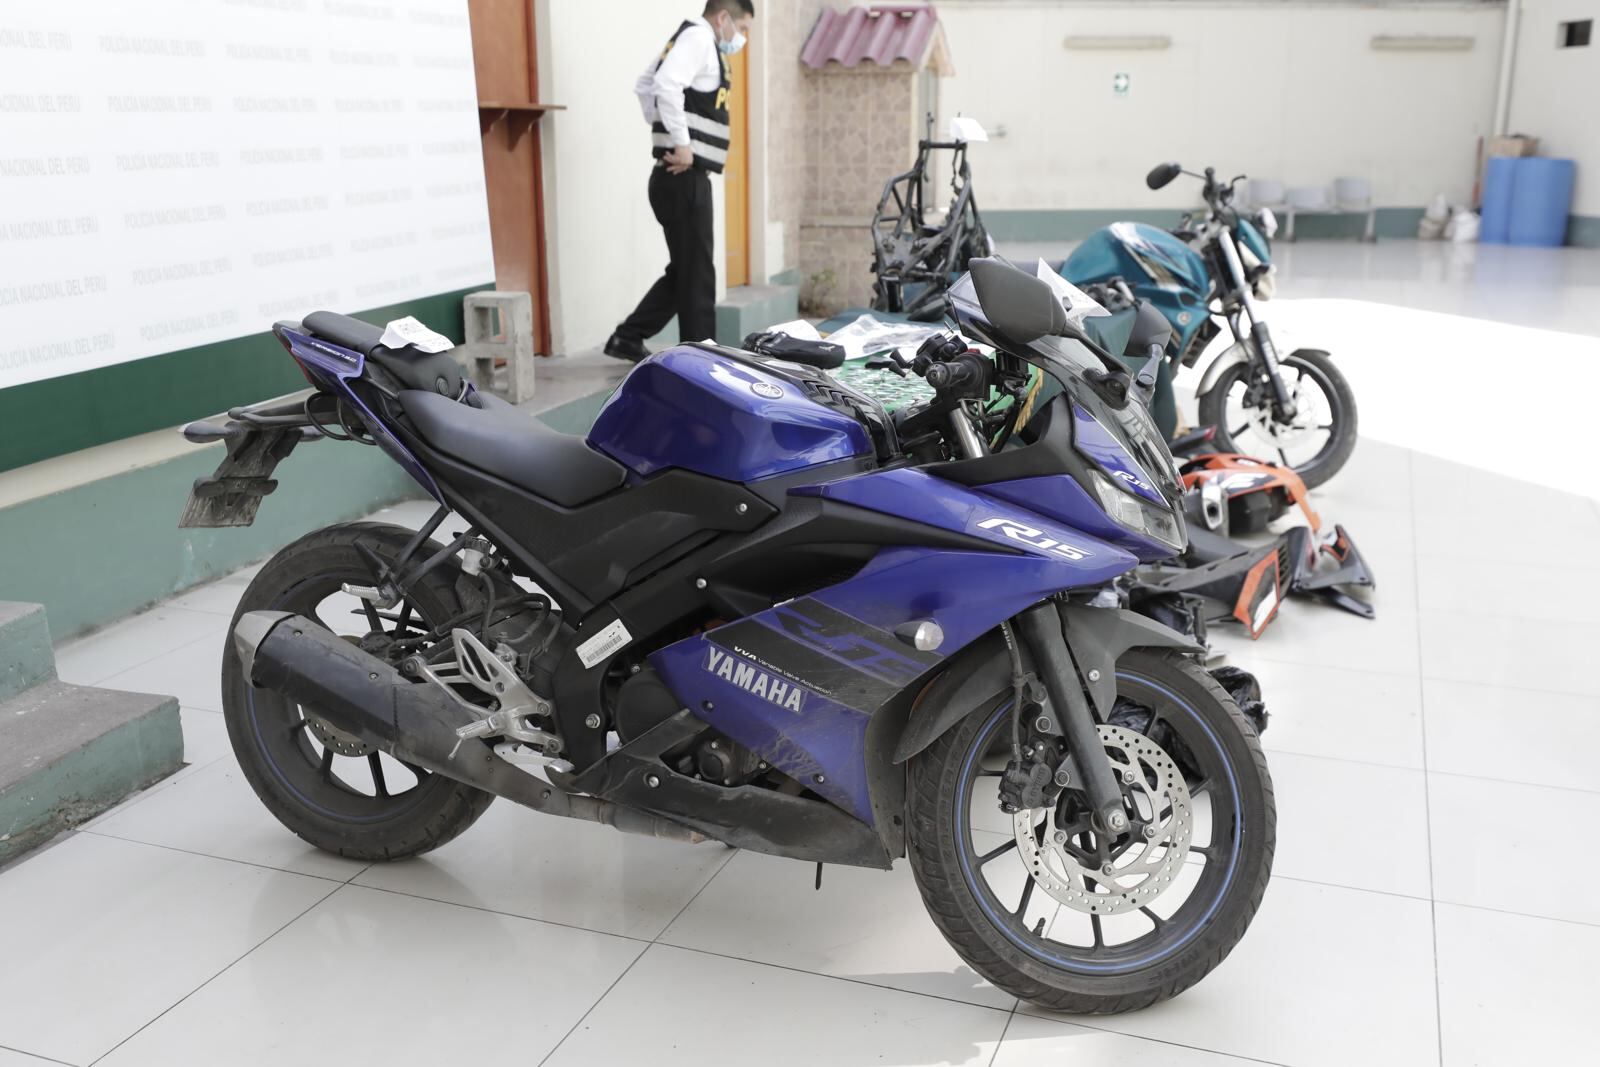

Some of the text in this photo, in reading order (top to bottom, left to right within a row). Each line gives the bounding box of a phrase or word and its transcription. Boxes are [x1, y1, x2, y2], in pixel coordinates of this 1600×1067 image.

[29, 31, 47, 49] DEL
[39, 95, 56, 112] DEL
[48, 157, 66, 175] DEL
[9, 220, 56, 240] NACIONAL
[57, 219, 74, 236] DEL
[20, 280, 66, 302] NACIONAL
[66, 279, 83, 297] DEL
[29, 337, 74, 362] NACIONAL
[74, 334, 92, 354] DEL
[1112, 470, 1150, 491] R15
[977, 518, 1094, 561] R15
[706, 646, 803, 712] YAMAHA
[733, 645, 832, 695] VVA Variable Valve Actuation
